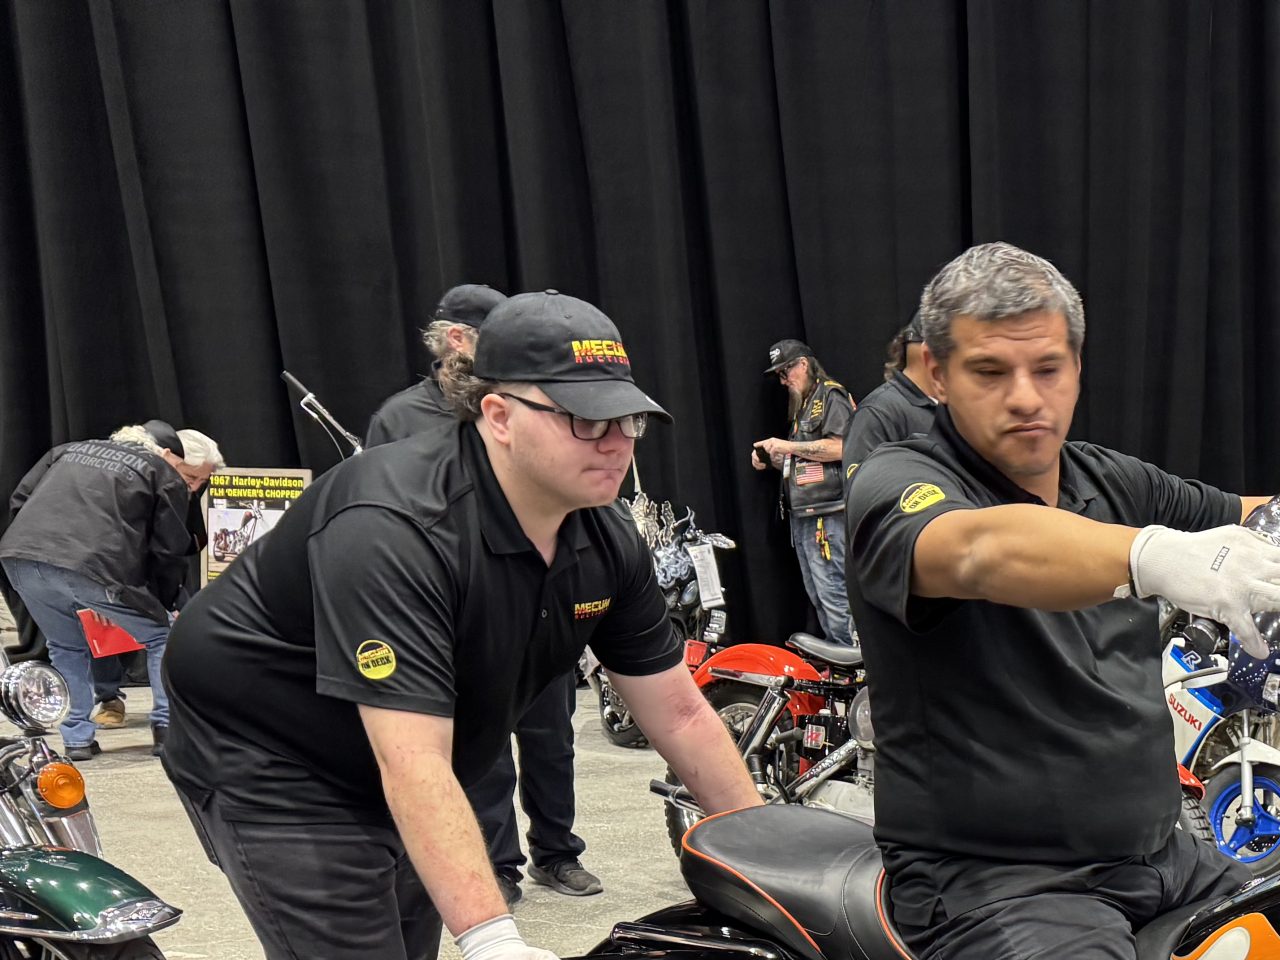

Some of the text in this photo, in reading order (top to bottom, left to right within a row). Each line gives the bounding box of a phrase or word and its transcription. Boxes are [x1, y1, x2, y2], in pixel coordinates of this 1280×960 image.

[66, 443, 148, 471] DAVIDSON
[209, 475, 304, 488] 1967 Harley-Davidson
[209, 487, 224, 497] FLH
[1168, 693, 1203, 731] SUZUKI
